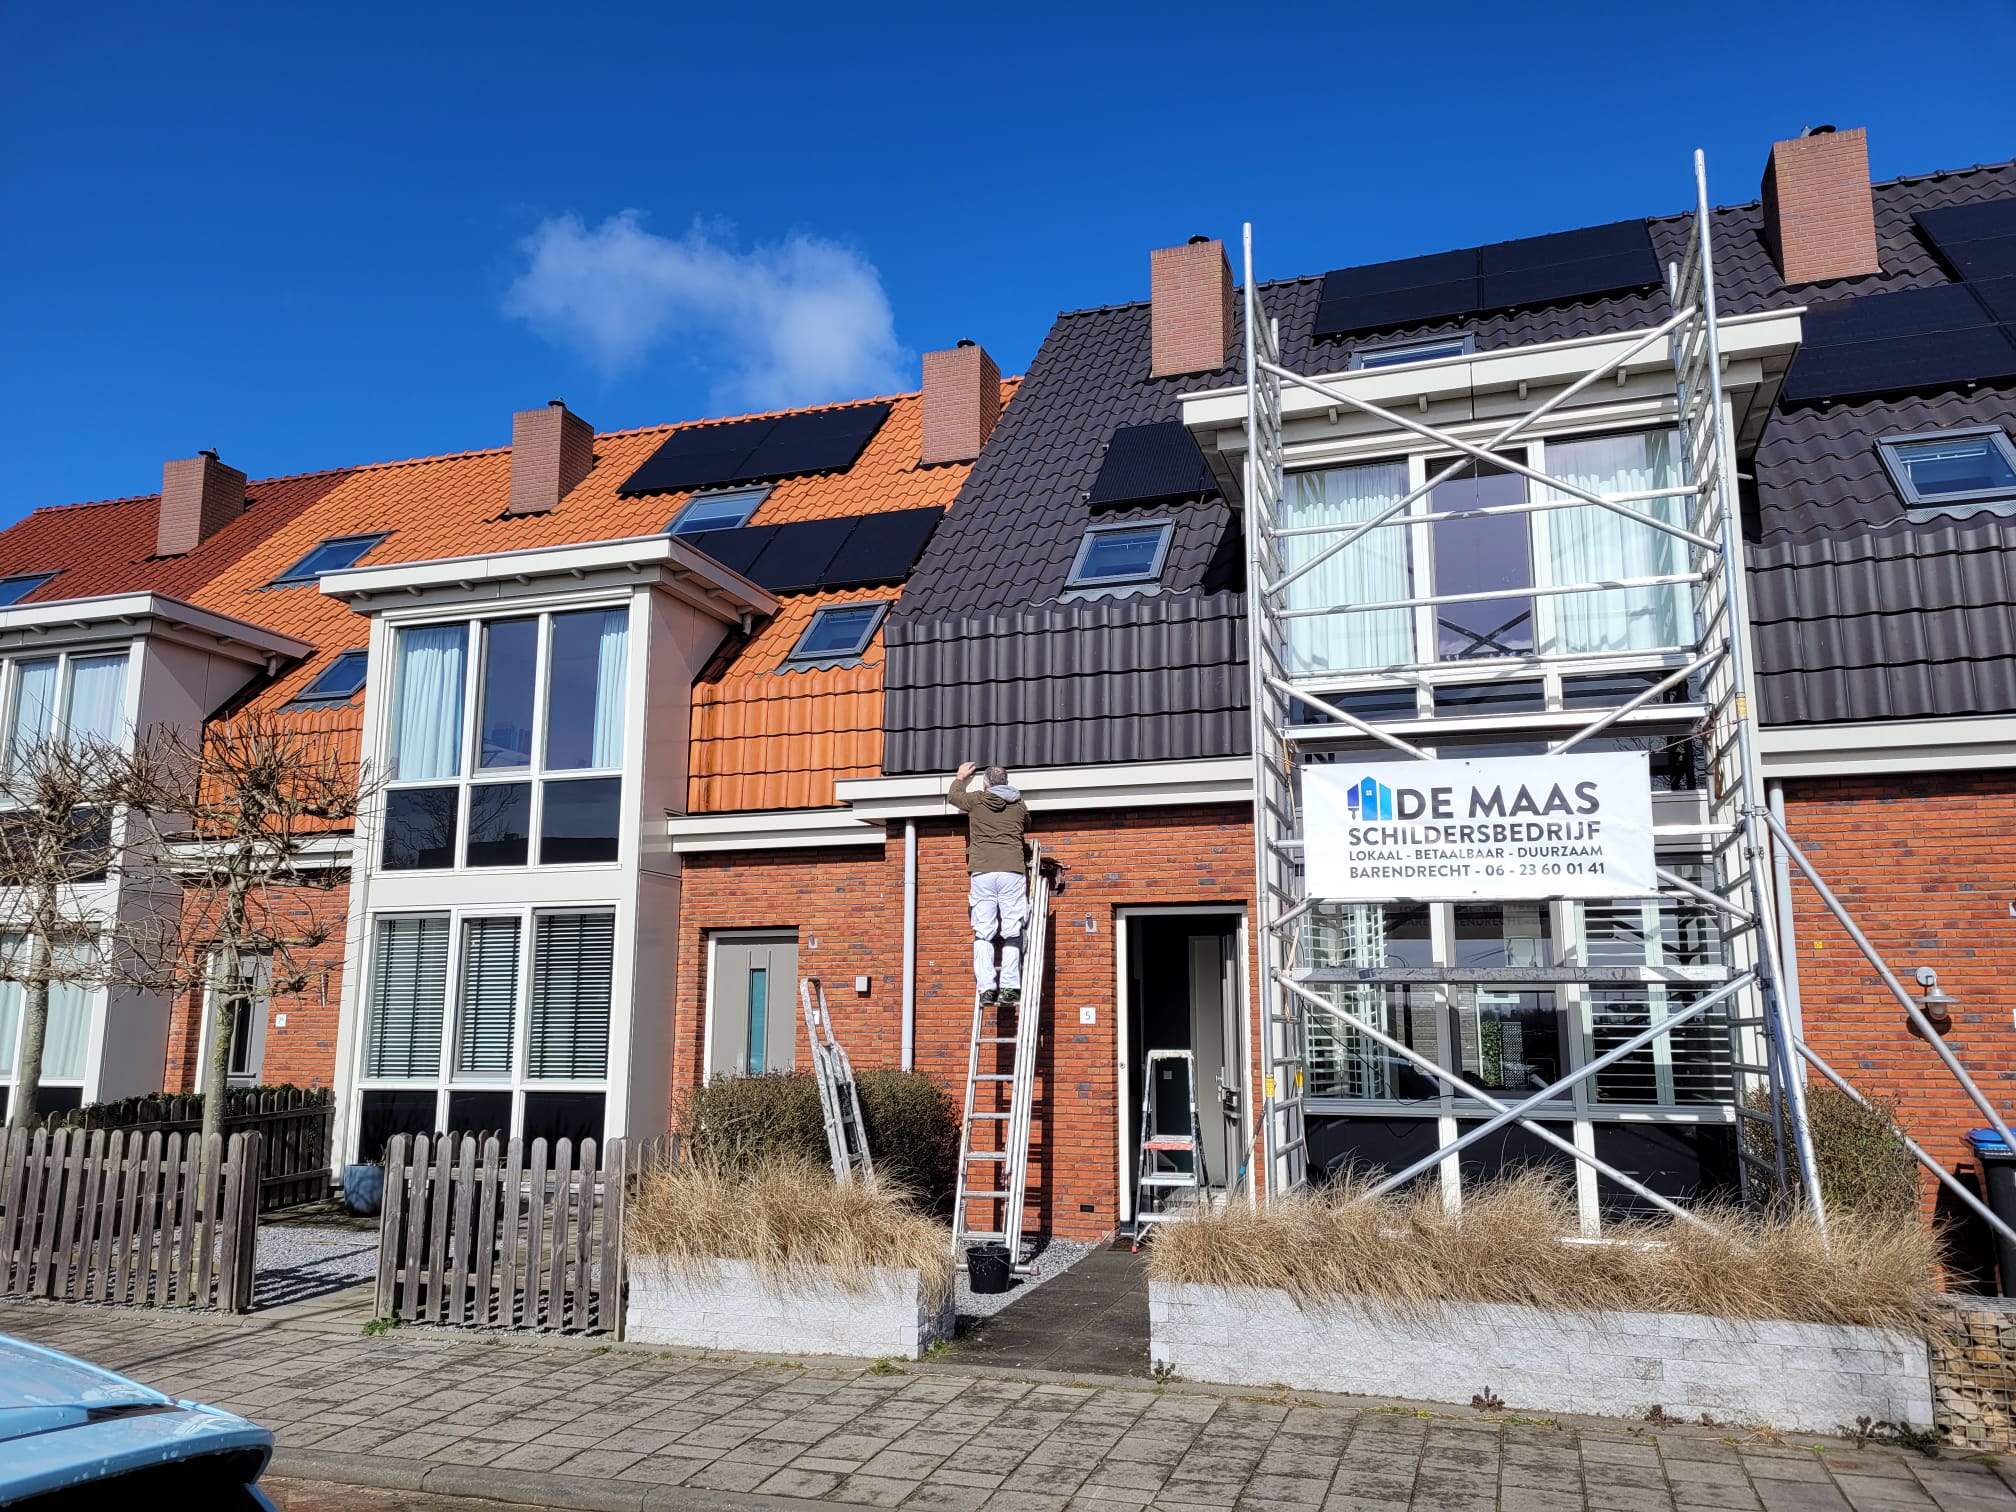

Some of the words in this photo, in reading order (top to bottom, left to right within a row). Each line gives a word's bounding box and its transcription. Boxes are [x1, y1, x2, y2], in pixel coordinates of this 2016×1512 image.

[1396, 787, 1454, 821] DE
[1468, 781, 1600, 818] MAAS
[1348, 820, 1601, 846] SCHILDERSBEDRIJF
[1349, 849, 1404, 861] LOKAAL
[1415, 847, 1505, 860] BETAALBAAR
[1517, 845, 1603, 858] DUURZAAM
[1350, 864, 1471, 879] BARENDRECHT
[1485, 864, 1505, 877] 06
[1519, 863, 1537, 876] 23
[1541, 862, 1562, 876] 60
[1566, 862, 1583, 875] 01
[1588, 861, 1605, 875] 41
[1085, 1010, 1091, 1021] 5
